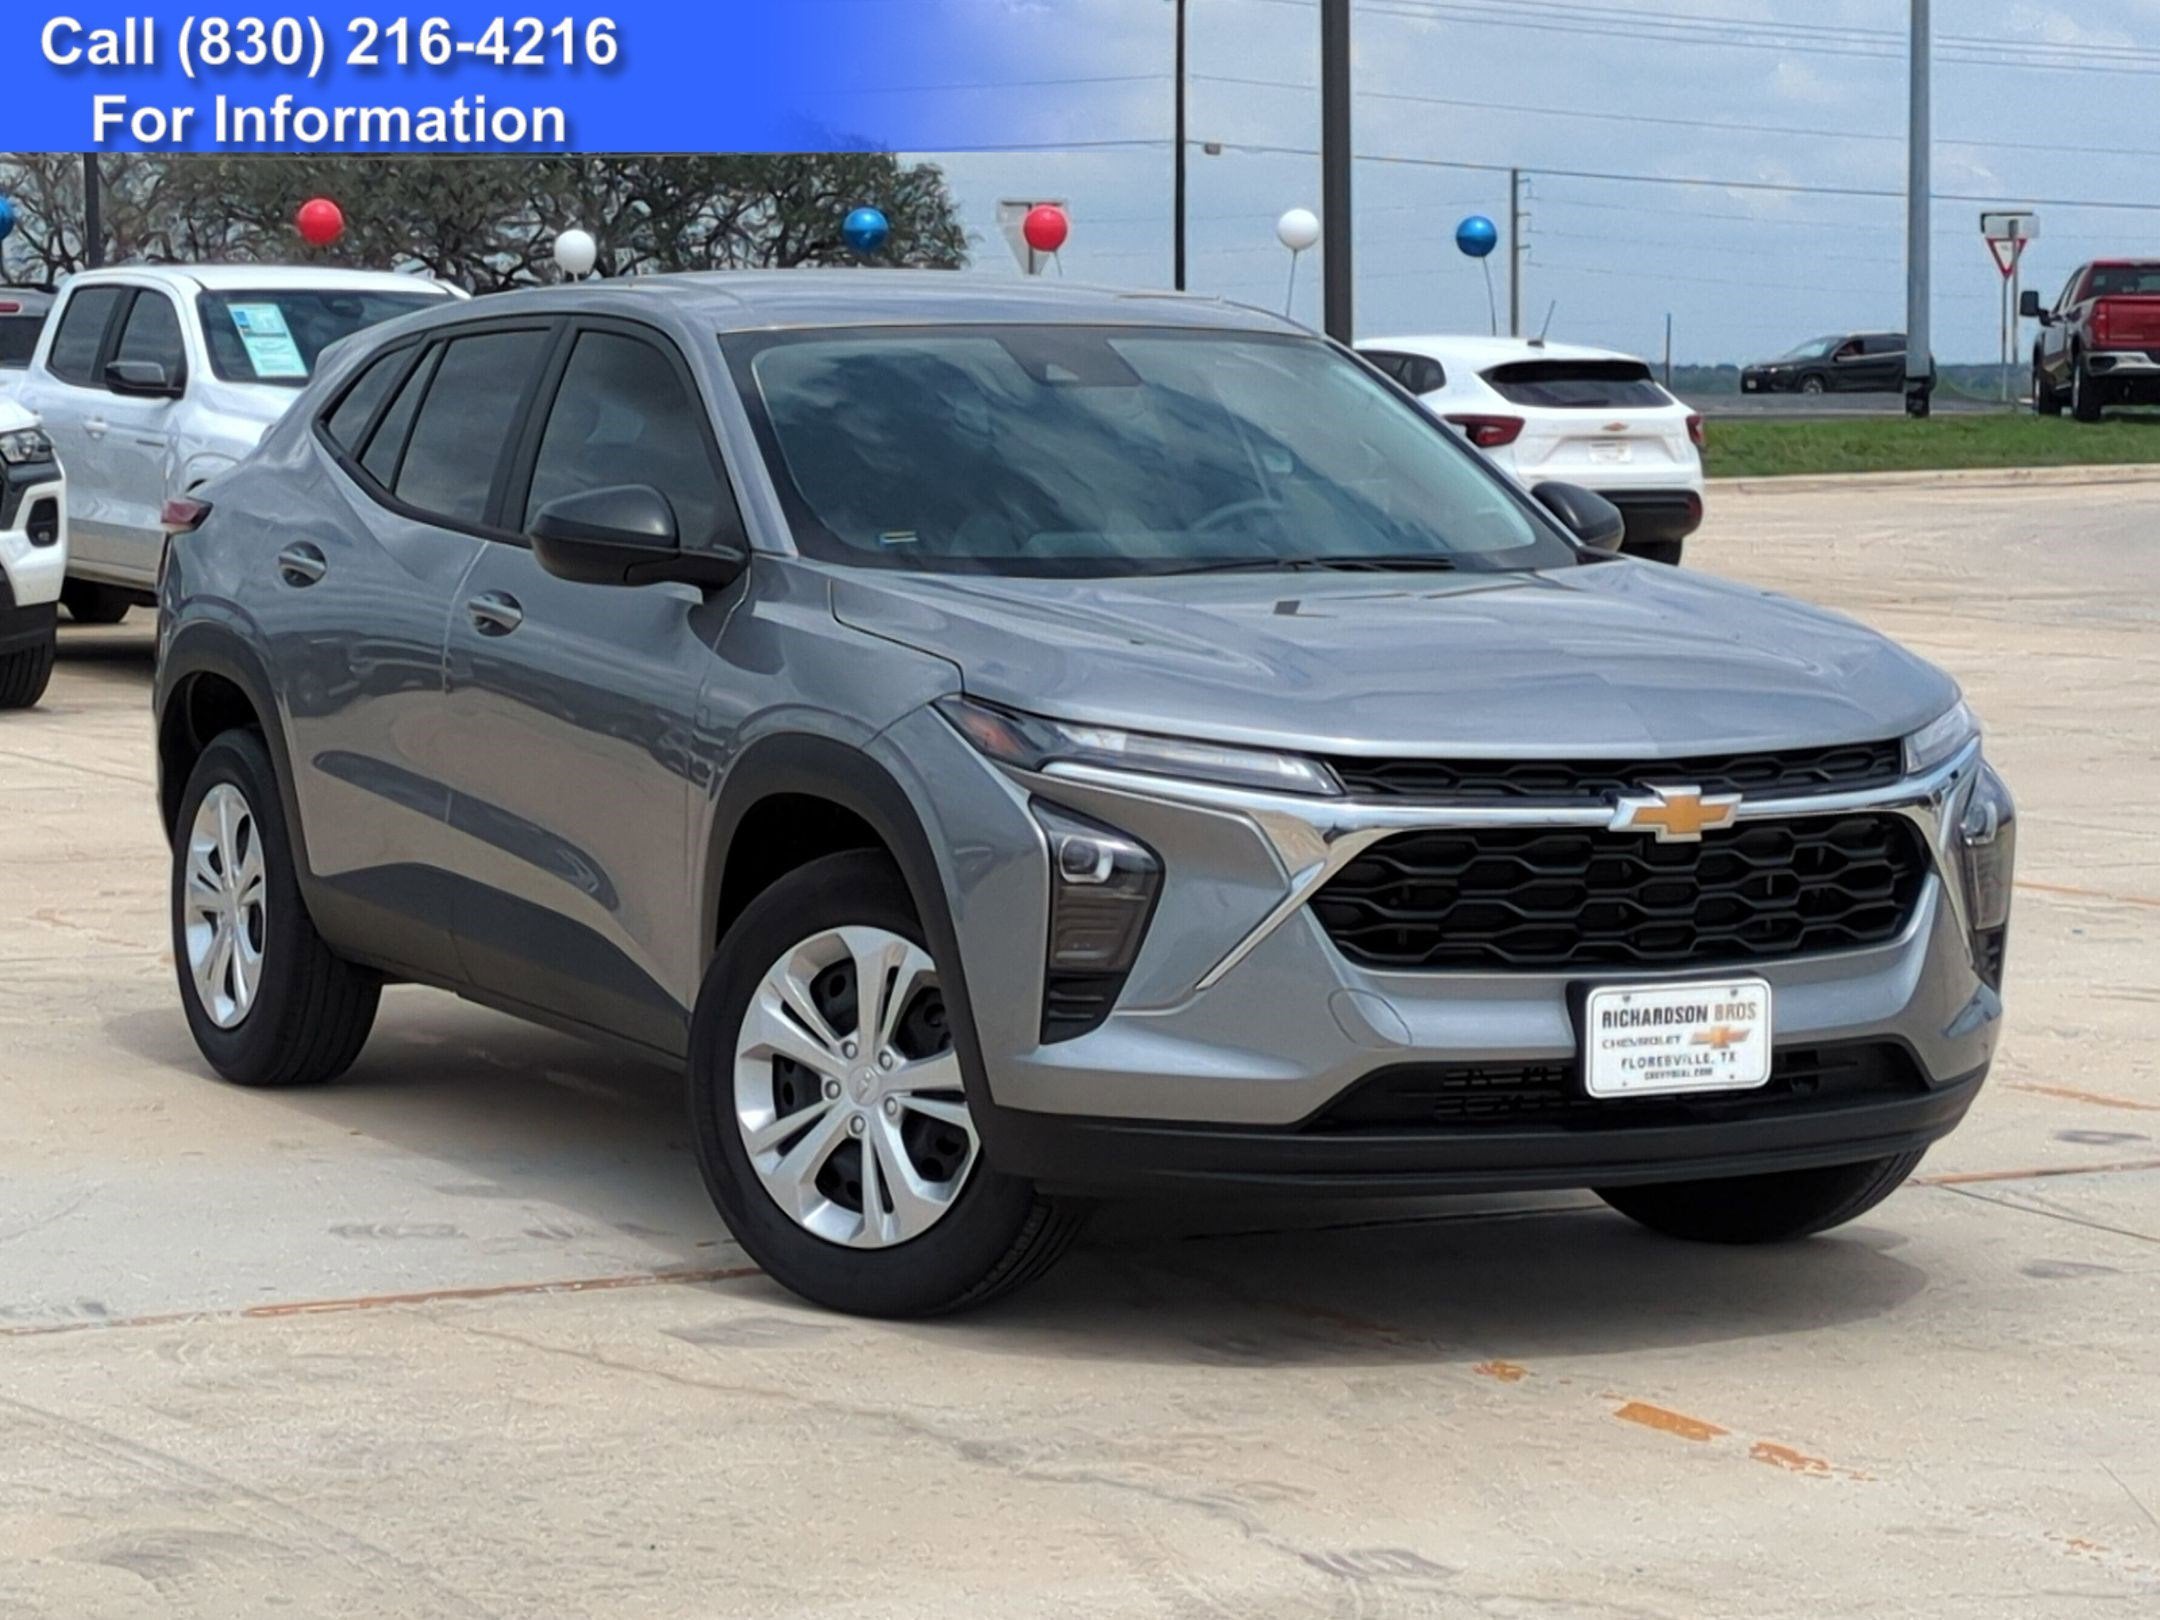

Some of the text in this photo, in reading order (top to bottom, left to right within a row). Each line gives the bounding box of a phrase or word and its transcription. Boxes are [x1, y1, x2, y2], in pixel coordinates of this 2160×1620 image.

[1602, 1002, 1757, 1029] RICHARDSON BROS
[1602, 1034, 1682, 1050] CHEVROLET
